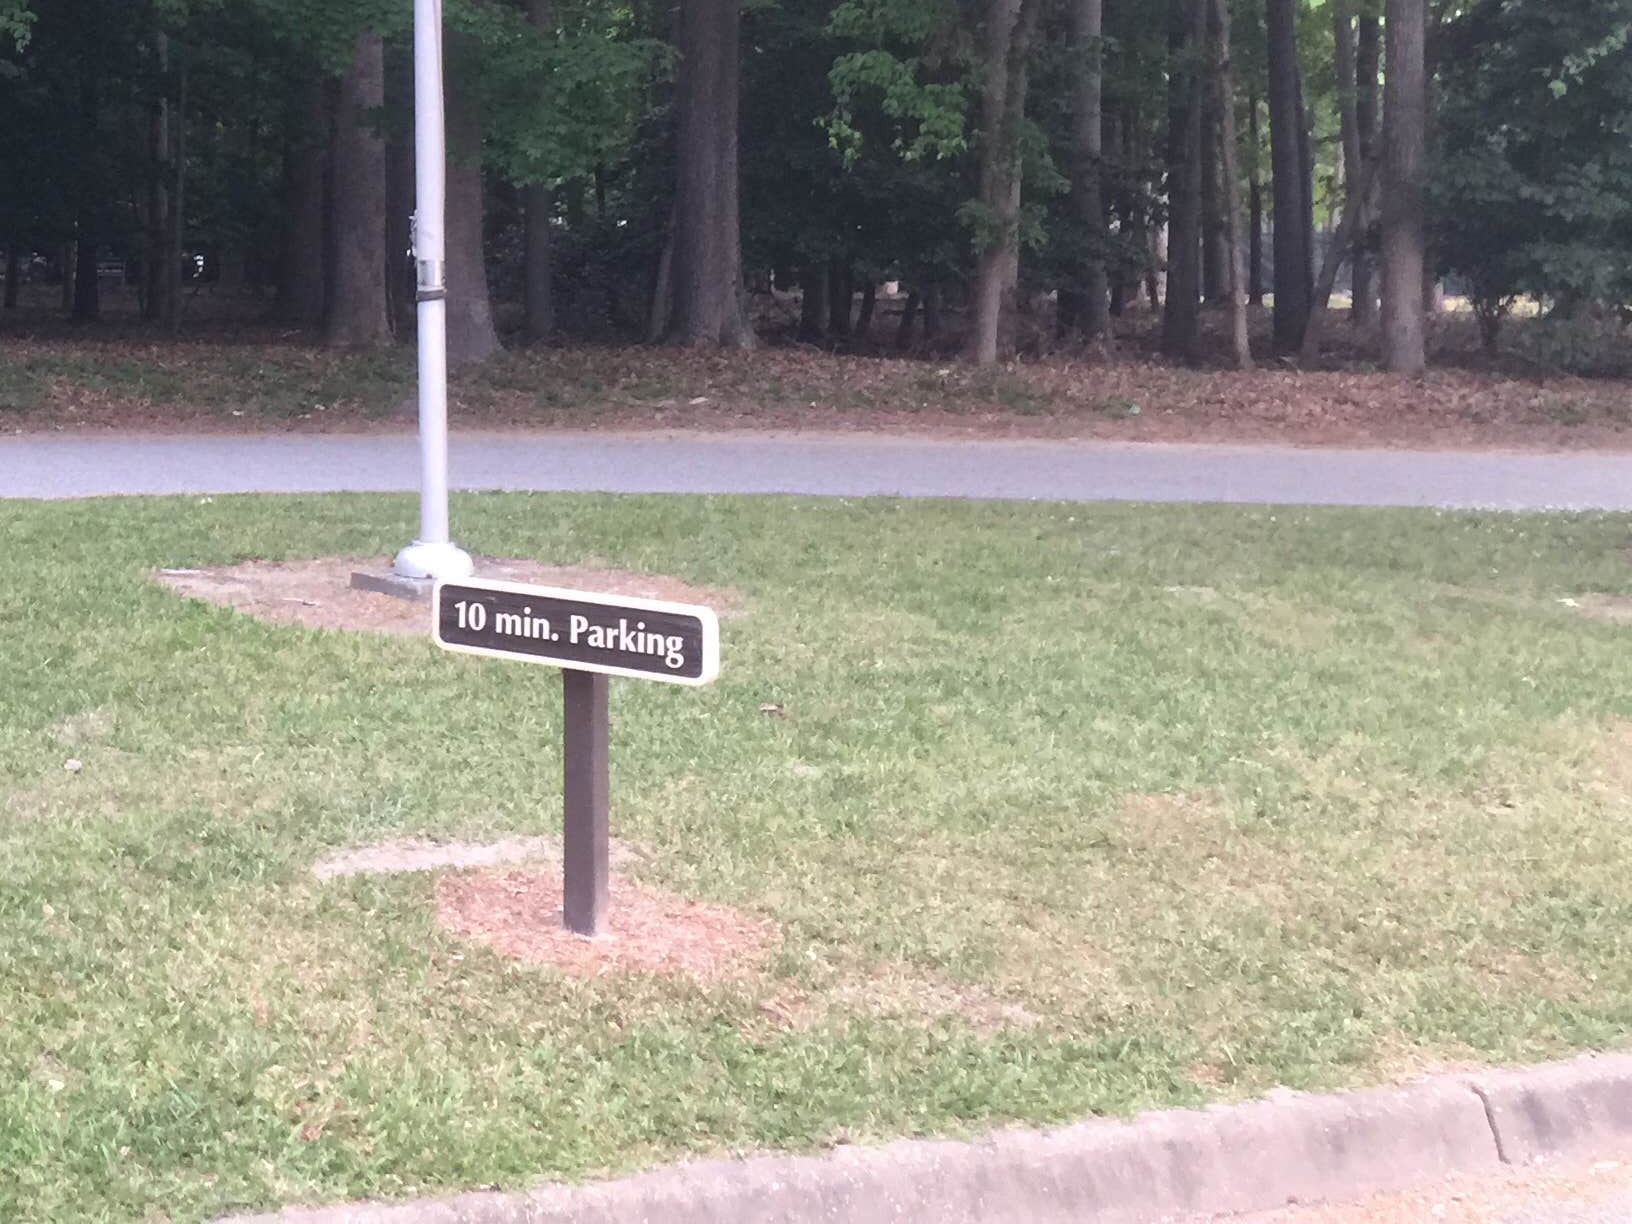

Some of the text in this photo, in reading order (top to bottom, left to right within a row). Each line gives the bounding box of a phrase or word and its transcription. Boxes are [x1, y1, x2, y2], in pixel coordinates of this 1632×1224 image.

[454, 600, 685, 668] 10 min. Parking
